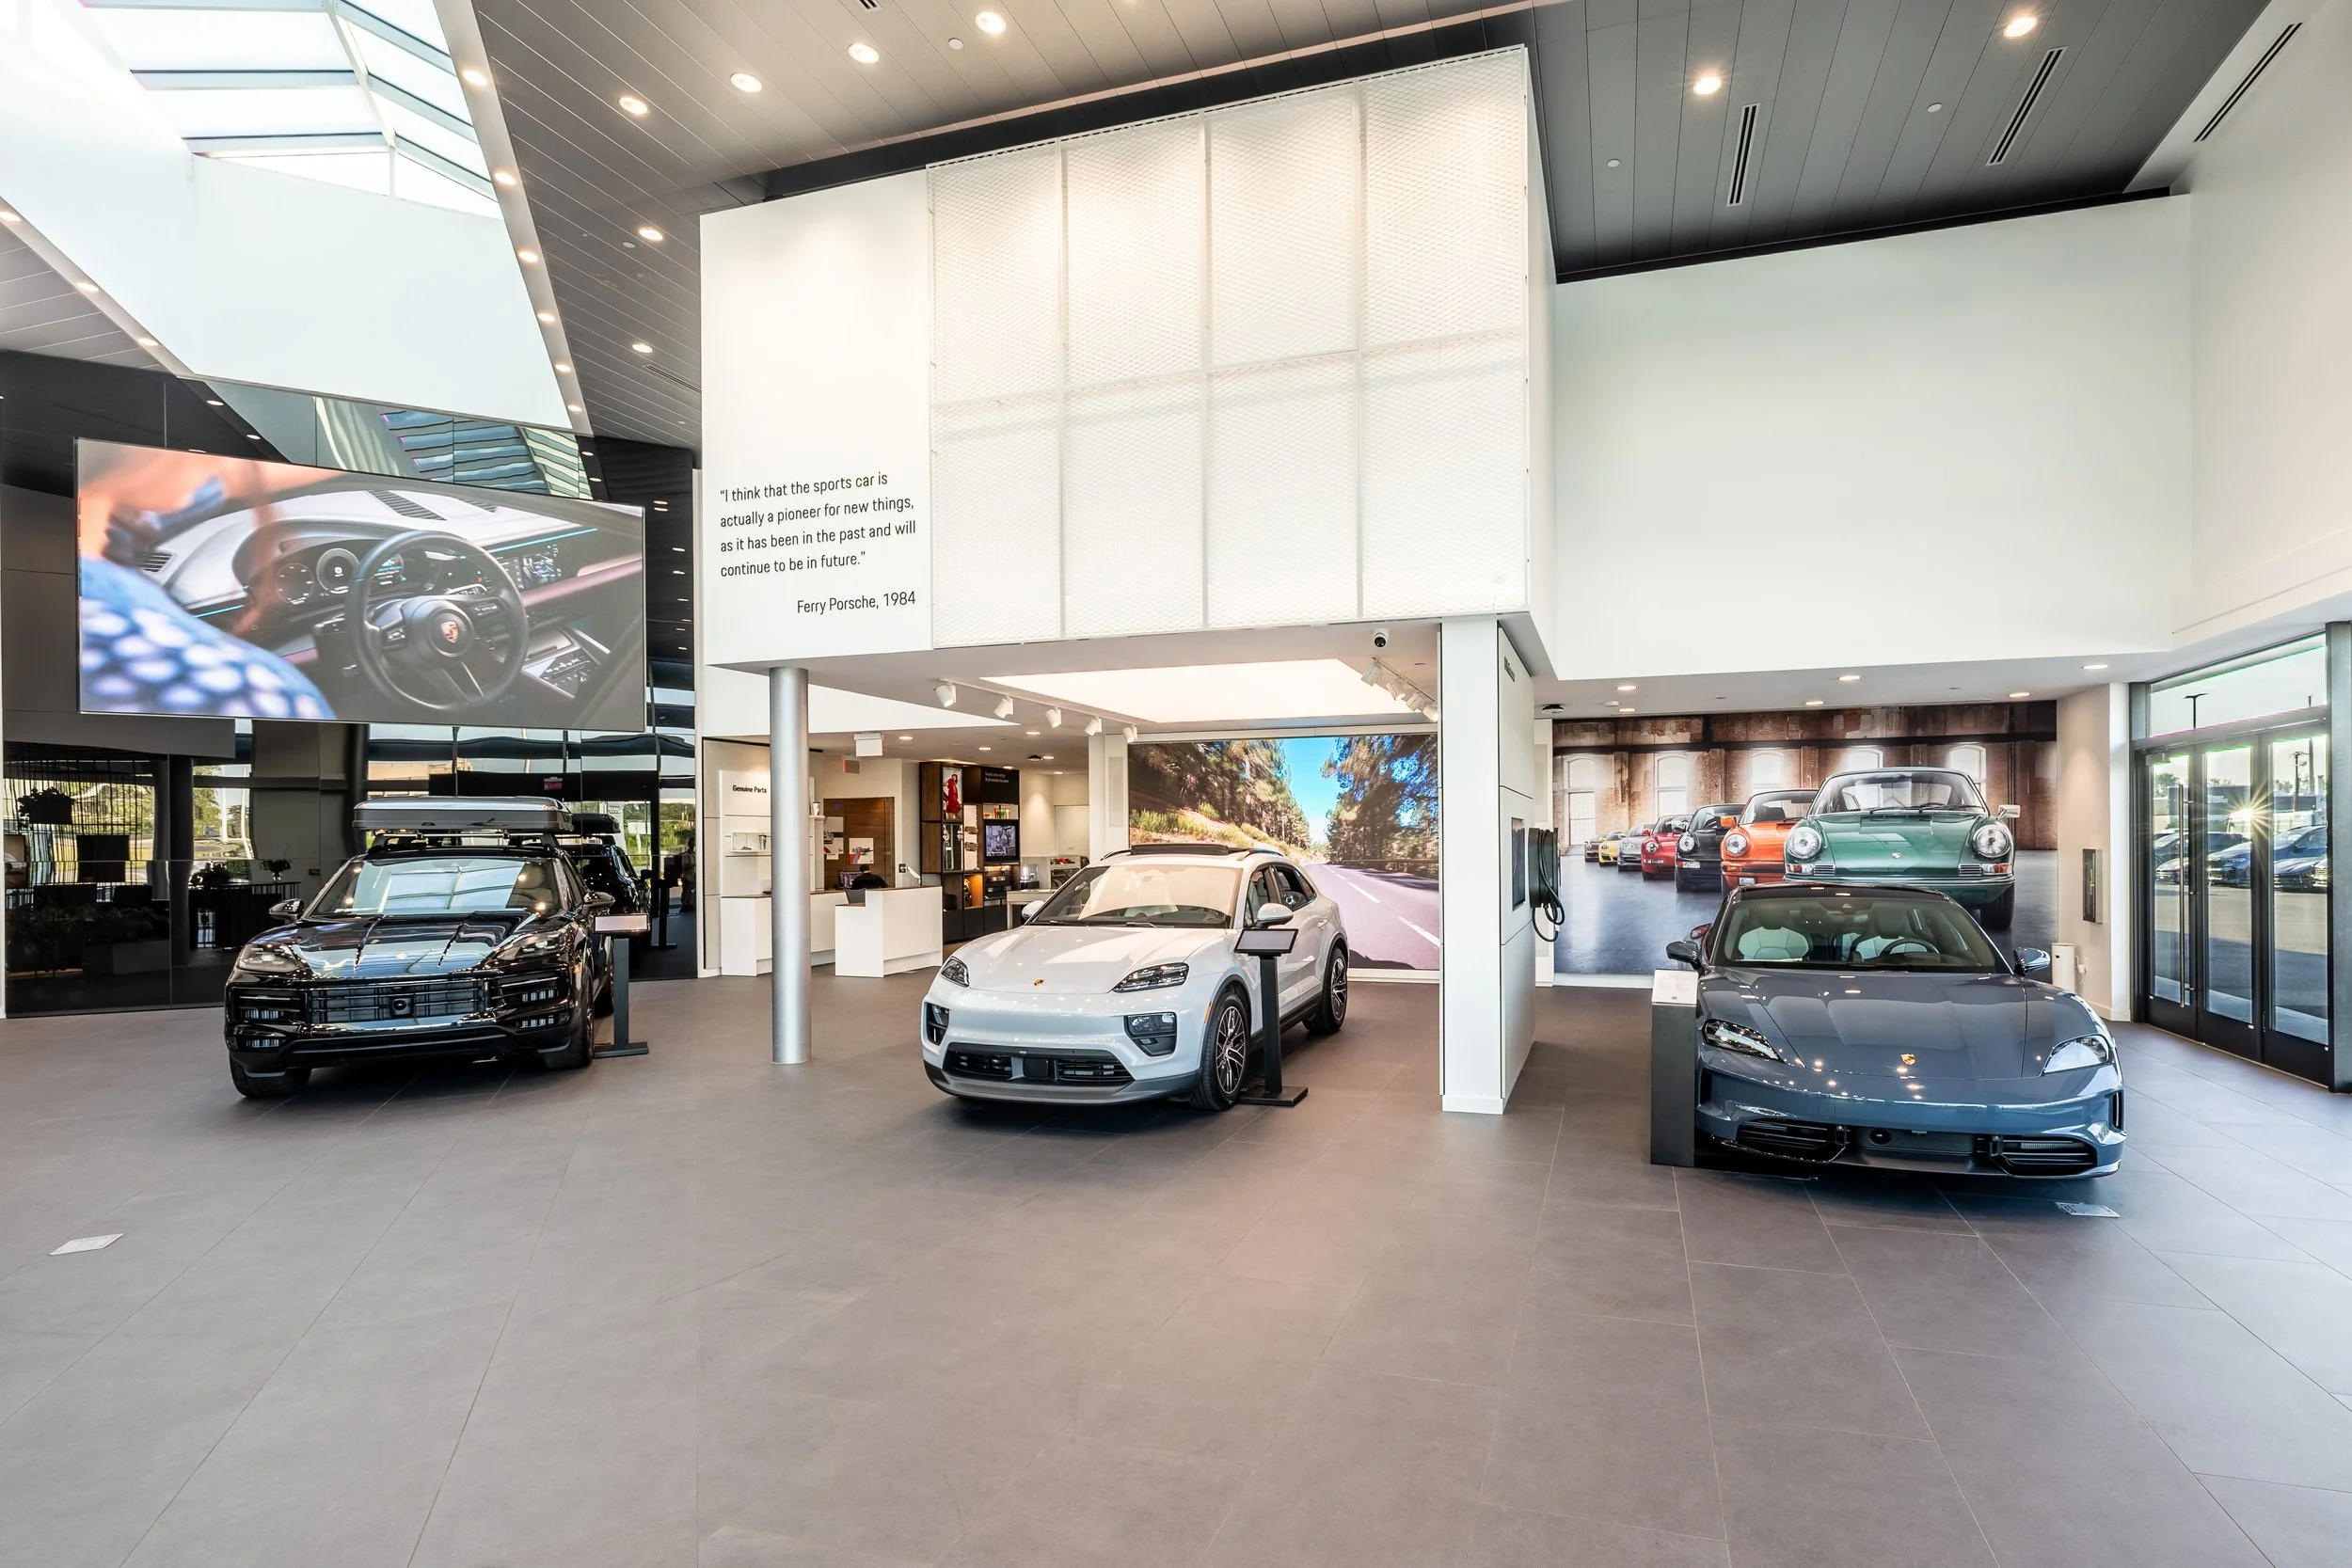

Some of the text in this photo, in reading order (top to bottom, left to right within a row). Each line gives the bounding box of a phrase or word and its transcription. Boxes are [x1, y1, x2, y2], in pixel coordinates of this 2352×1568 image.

[732, 486, 761, 503] think
[764, 483, 788, 499] that
[790, 482, 810, 496] the
[813, 477, 852, 495] sports
[855, 475, 875, 488] car
[878, 471, 888, 485] is
[720, 497, 914, 528] actually a pioneer for new things,
[720, 519, 916, 553] as it has been in the past and will
[720, 560, 771, 578] continue
[773, 559, 786, 573] to
[788, 557, 803, 571] be
[806, 556, 818, 569] in
[797, 590, 916, 616] Ferry Porsche, 1984
